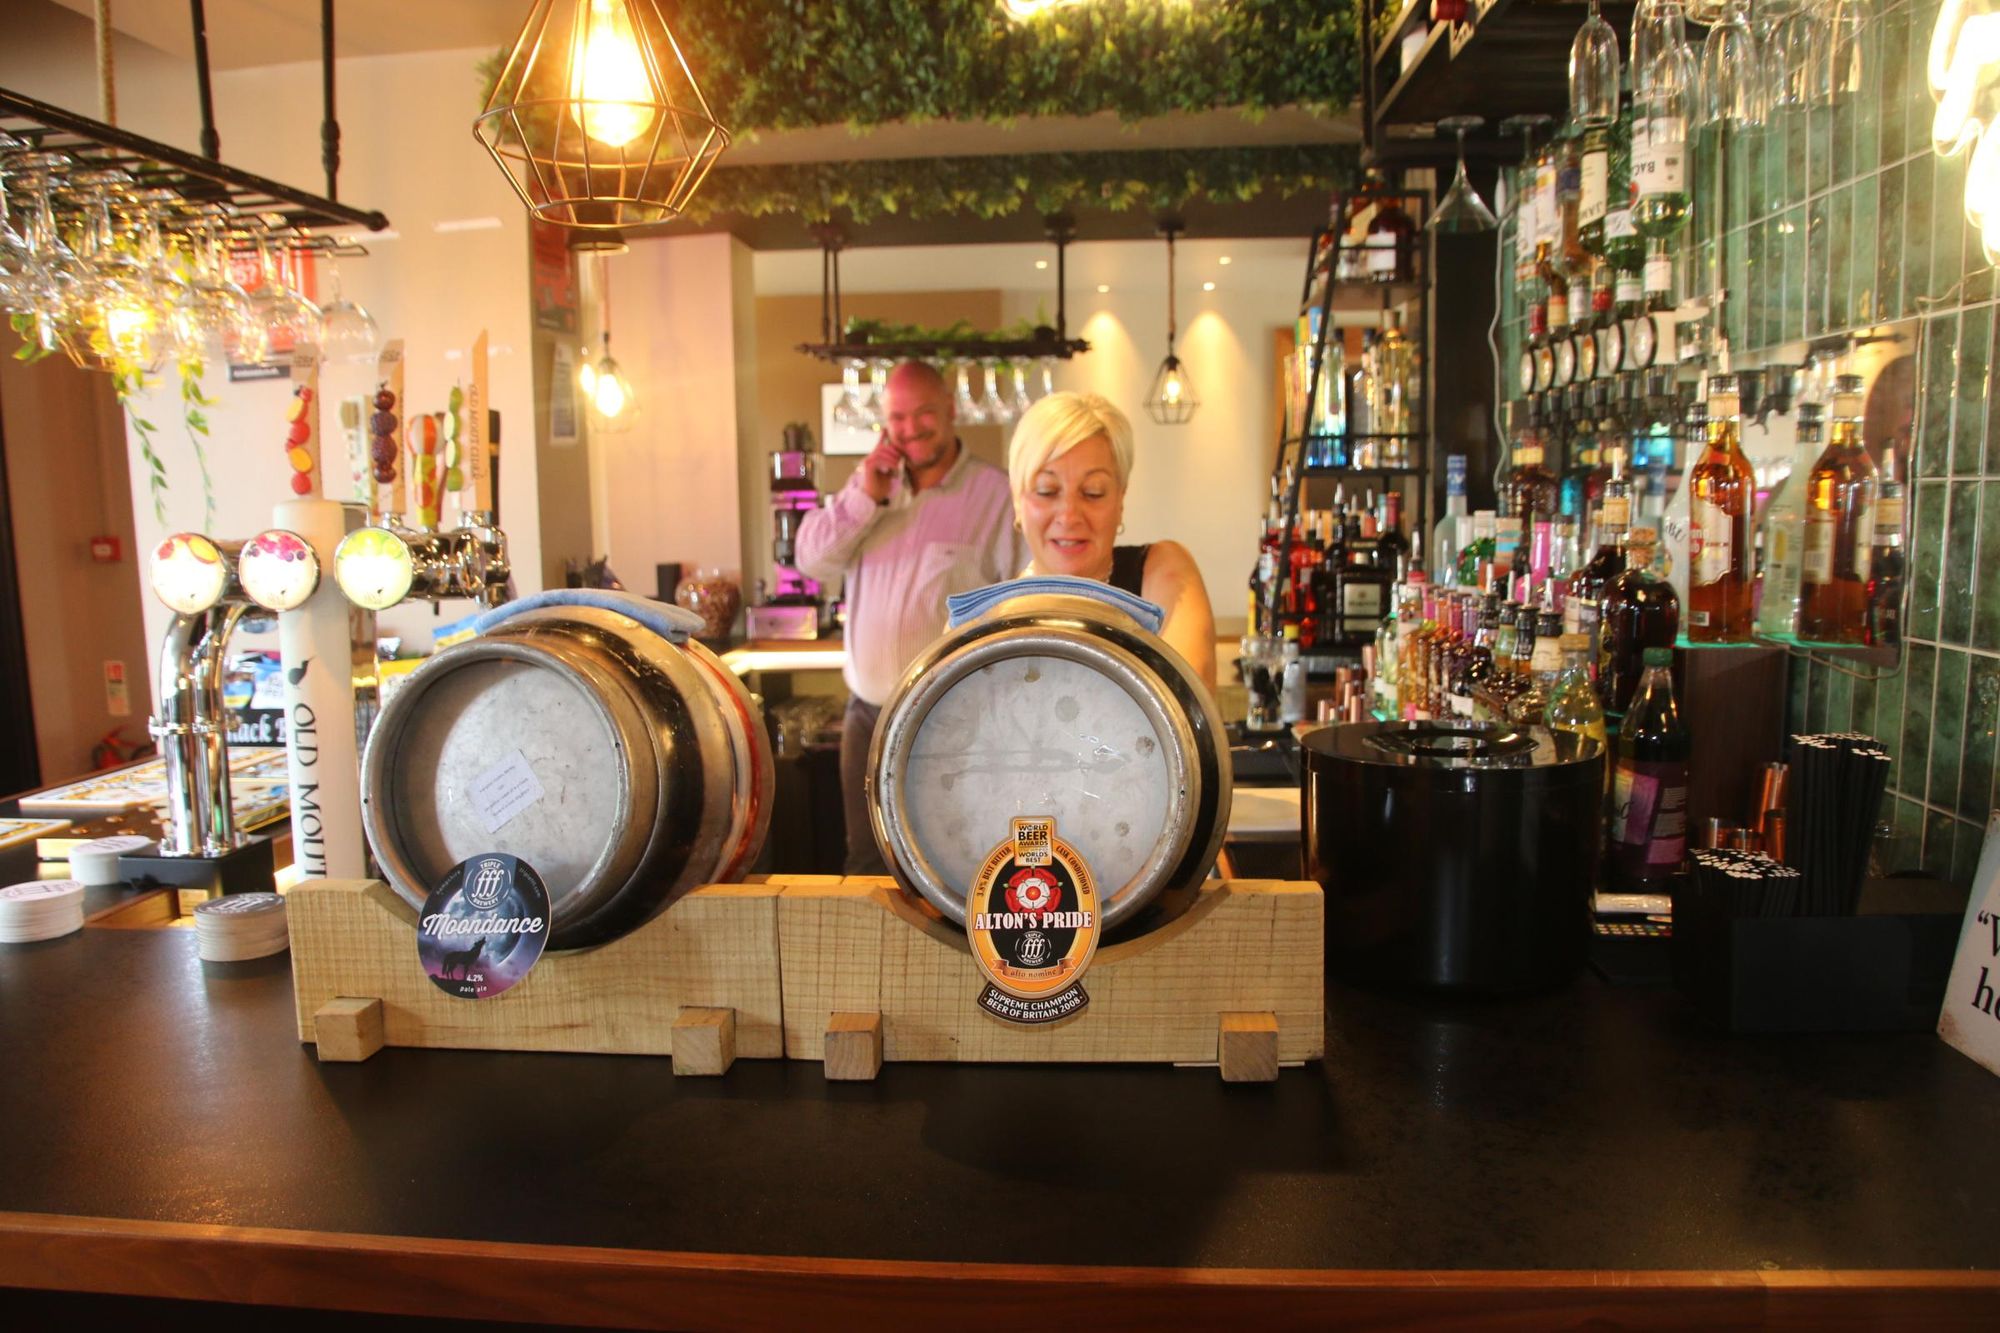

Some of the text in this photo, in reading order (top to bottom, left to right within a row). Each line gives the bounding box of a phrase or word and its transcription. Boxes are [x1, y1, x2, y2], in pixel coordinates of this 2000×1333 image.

[1633, 161, 1656, 175] BAC
[293, 703, 328, 879] OLD MOUT
[1018, 831, 1047, 840] BEER
[480, 861, 501, 869] TRIPLE
[983, 865, 995, 880] BEST
[991, 846, 1012, 866] BITTER
[1055, 845, 1090, 895] CASK CONDITIONED
[471, 869, 505, 898] fff
[473, 897, 499, 906] BREWERY
[423, 912, 545, 940] Moondance
[975, 911, 1093, 930] ALTON'S PRIDE
[1021, 938, 1045, 958] fff
[466, 974, 484, 982] 4.2%
[1010, 969, 1026, 977] alto
[986, 998, 1081, 1019] BEER OF BRITAIN 2008
[988, 988, 1079, 1011] SUPREME CHAMPION
